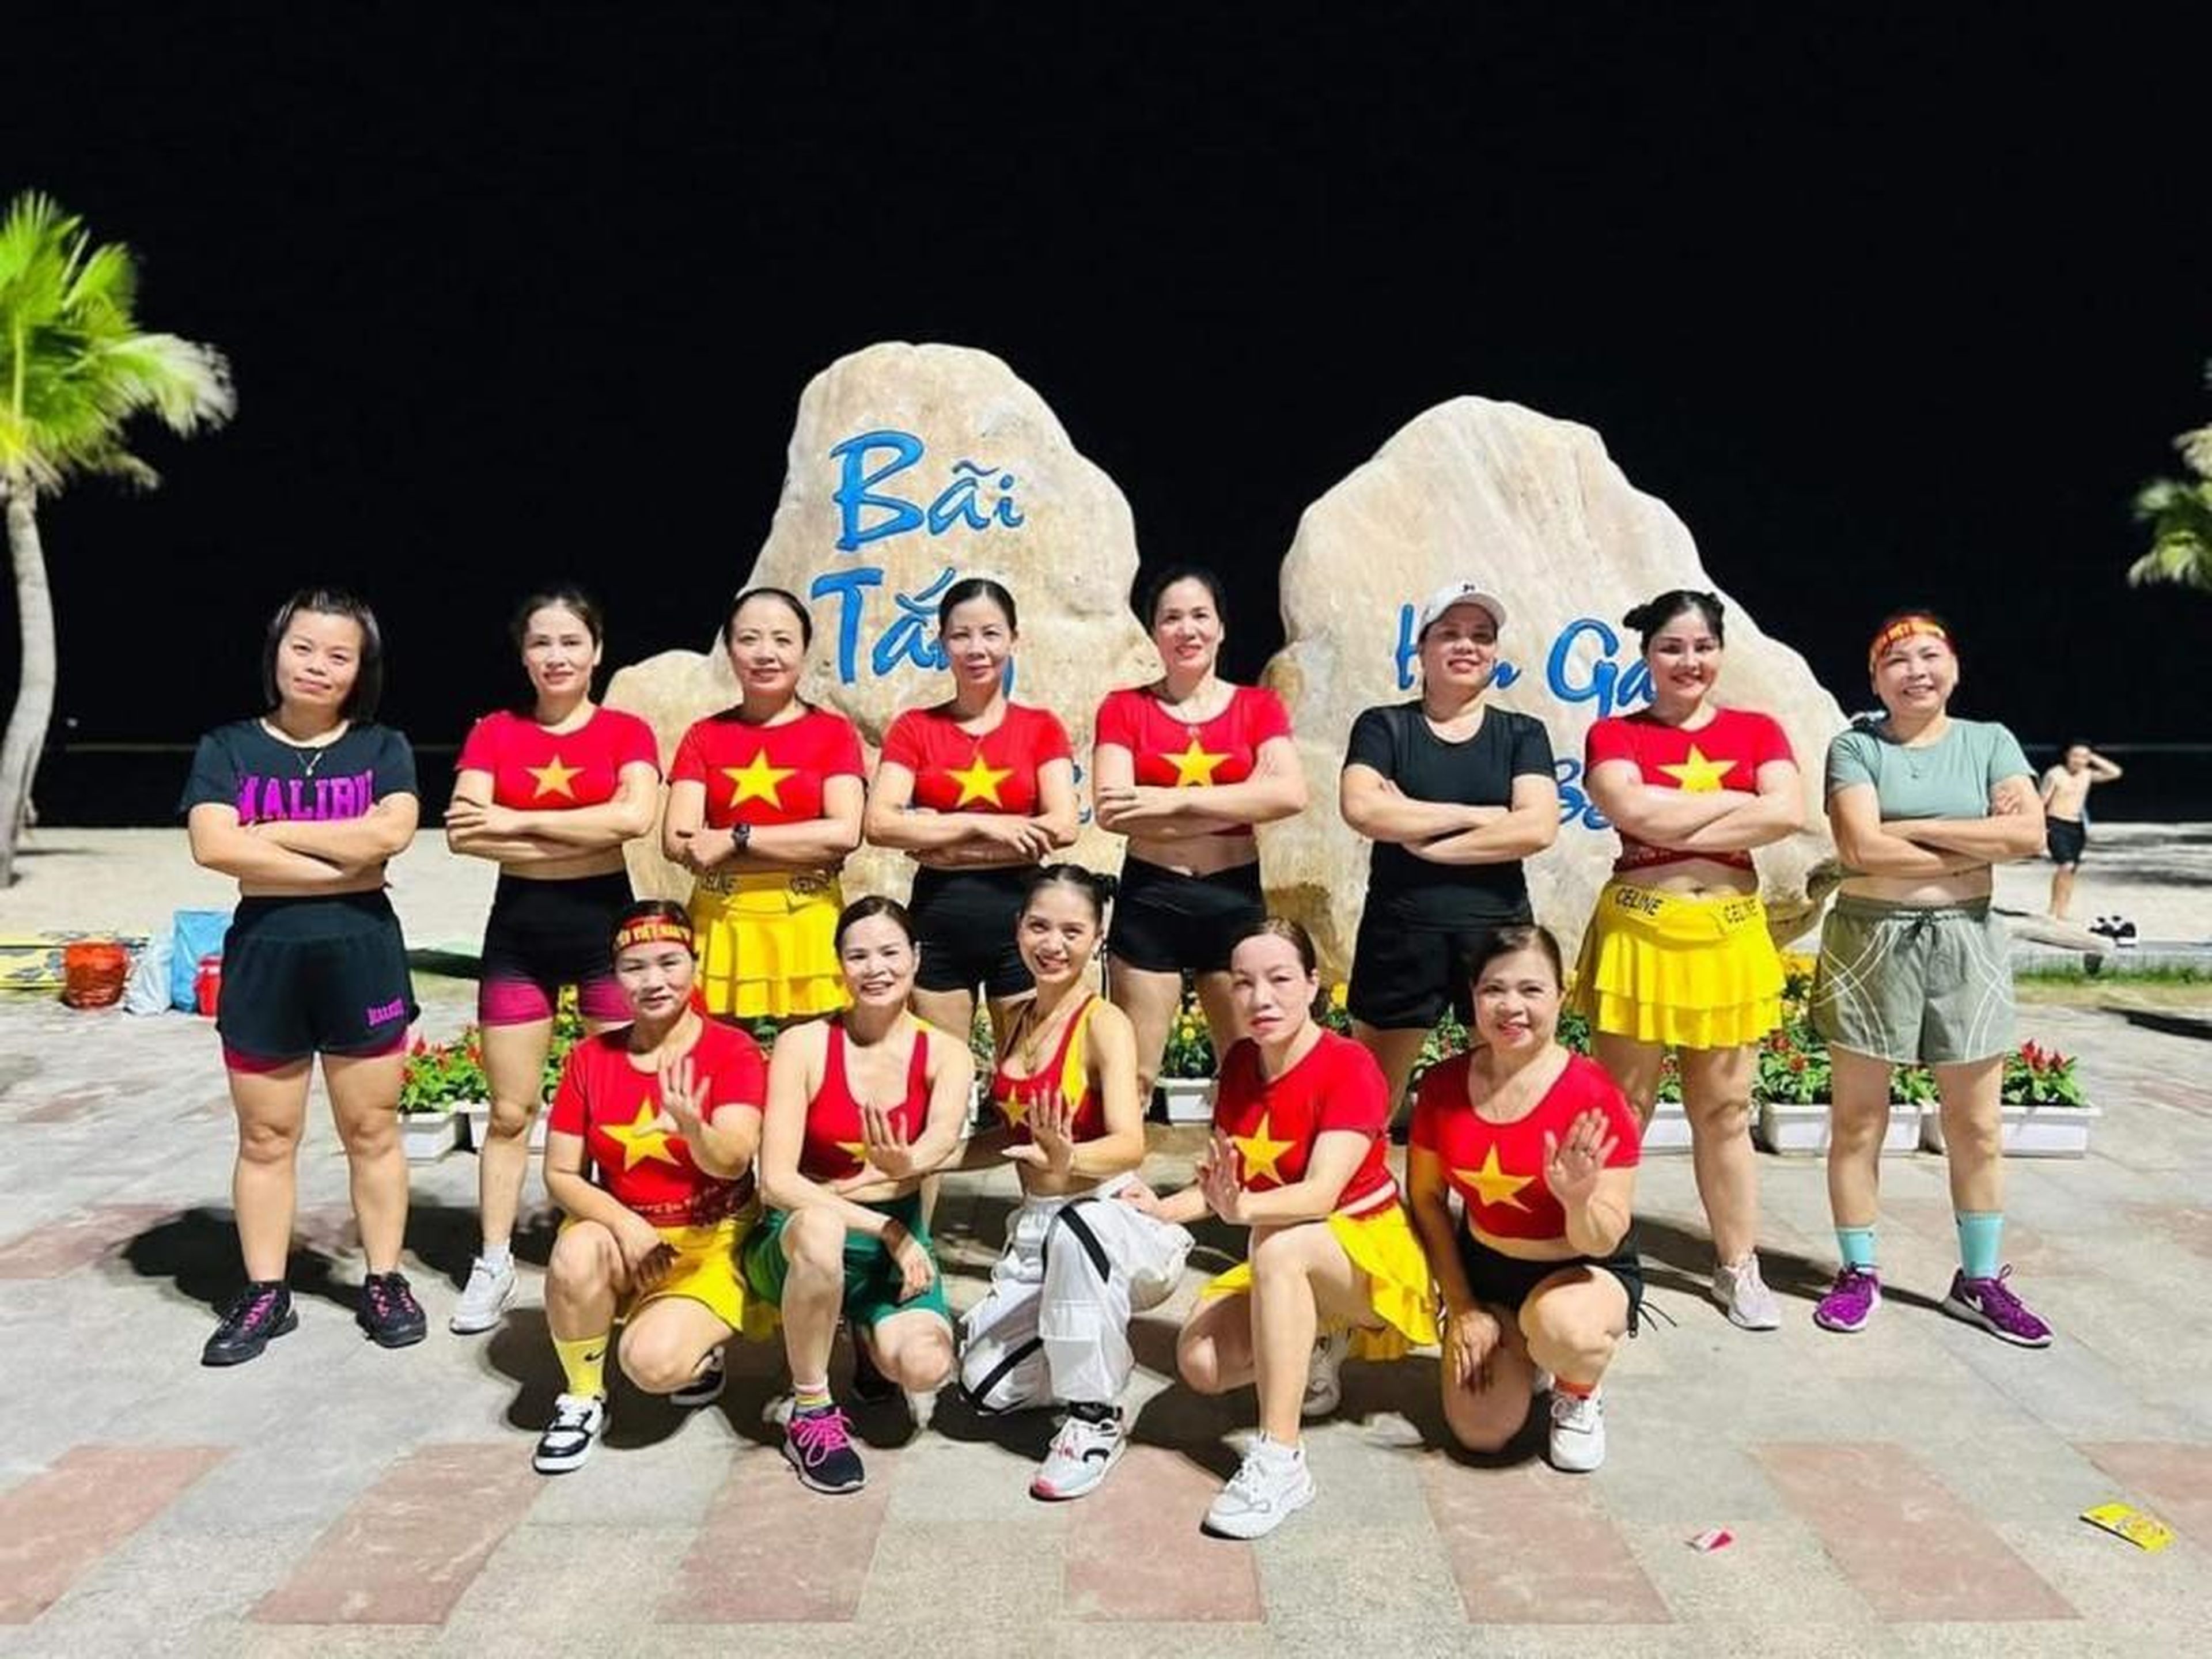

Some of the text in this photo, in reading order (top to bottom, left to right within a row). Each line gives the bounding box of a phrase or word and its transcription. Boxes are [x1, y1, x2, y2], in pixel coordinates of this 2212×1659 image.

[831, 429, 1025, 551] Bãi
[811, 567, 1015, 699] Tắ
[1547, 618, 1658, 720] Ga
[1615, 887, 1664, 916] CELINE
